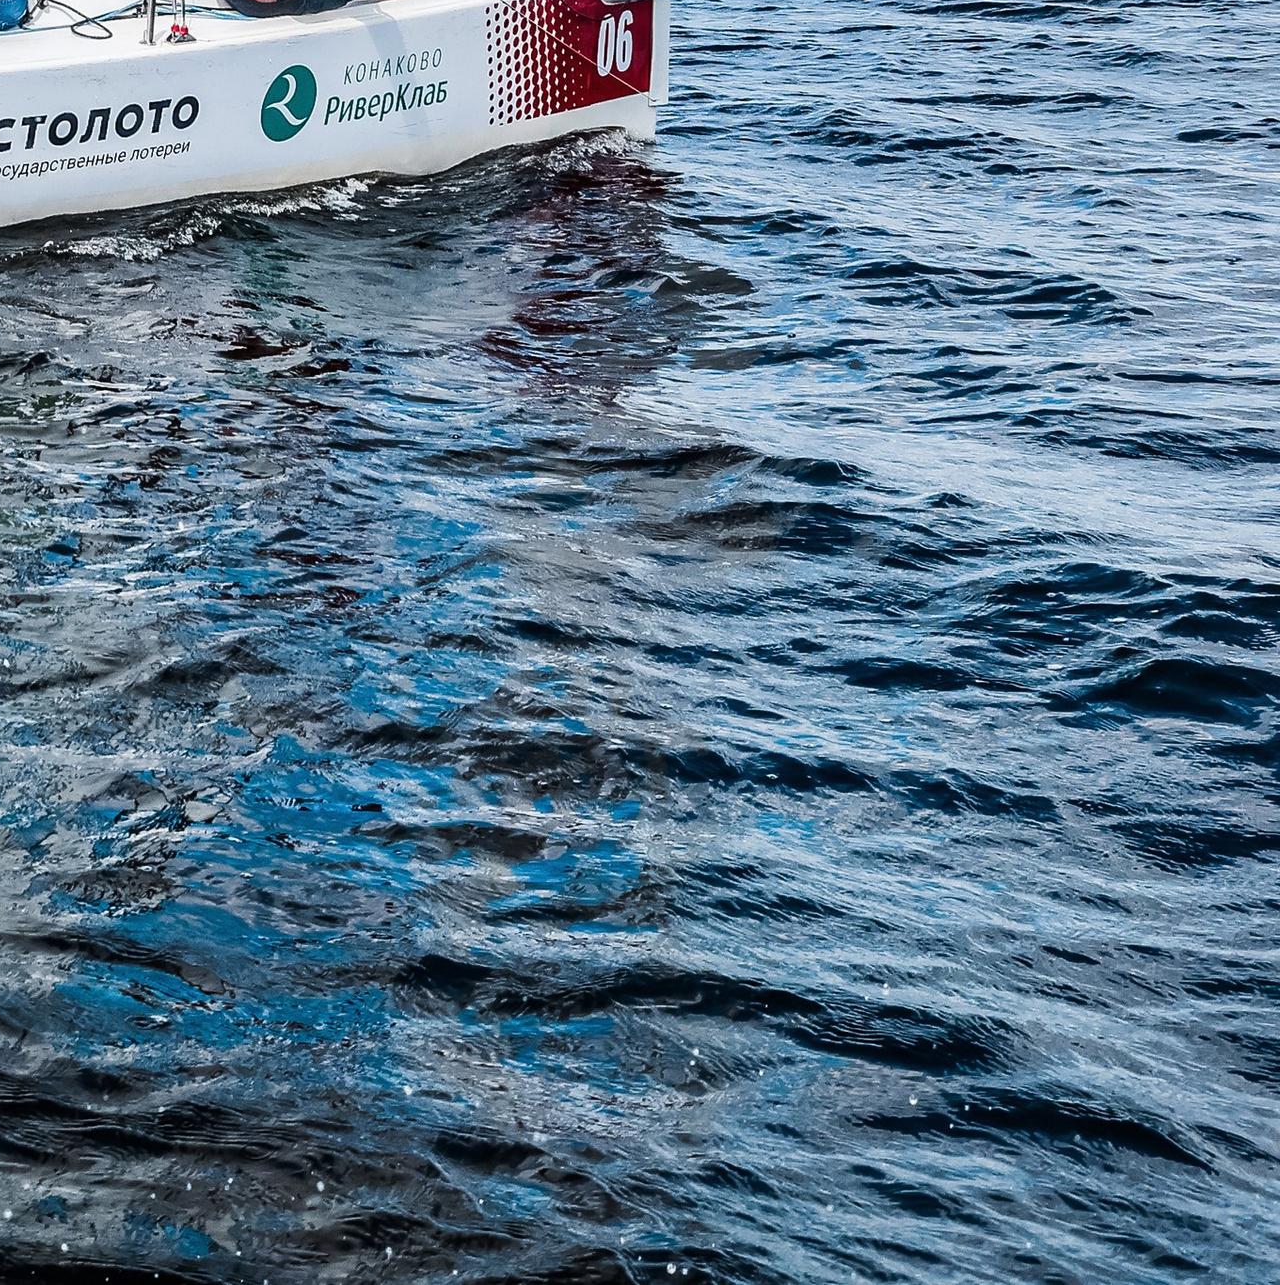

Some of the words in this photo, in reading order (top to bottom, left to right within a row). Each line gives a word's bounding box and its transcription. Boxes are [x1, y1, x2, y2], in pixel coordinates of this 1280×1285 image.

[596, 9, 634, 77] 06
[343, 48, 443, 86] КОНАКОВО
[323, 80, 449, 126] РиверКлаб
[129, 141, 191, 162] лотереи
